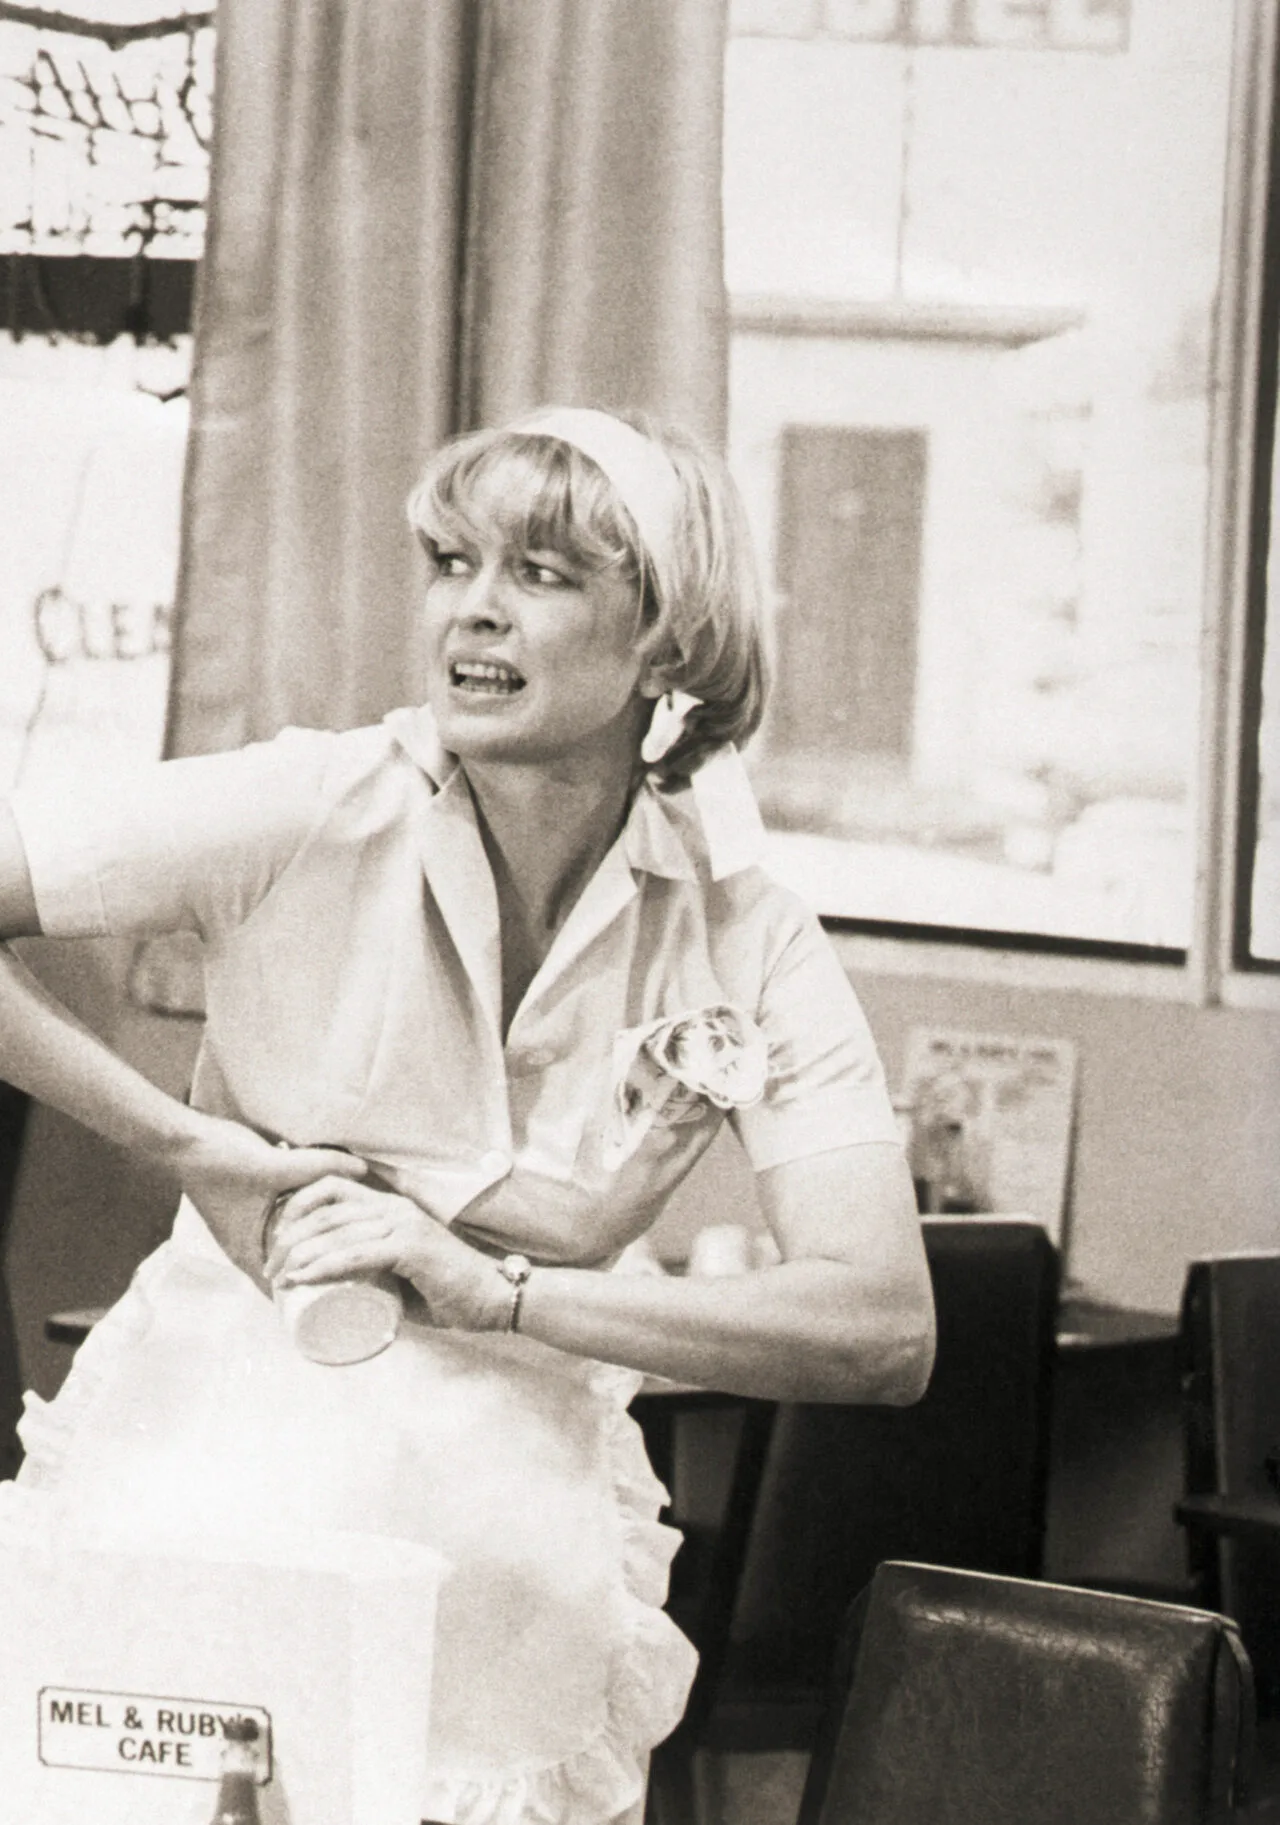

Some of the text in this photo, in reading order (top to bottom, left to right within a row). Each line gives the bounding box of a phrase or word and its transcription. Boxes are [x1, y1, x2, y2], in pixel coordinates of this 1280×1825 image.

[49, 1699, 111, 1728] MEL
[123, 1705, 144, 1730] &
[118, 1737, 193, 1767] CAFE
